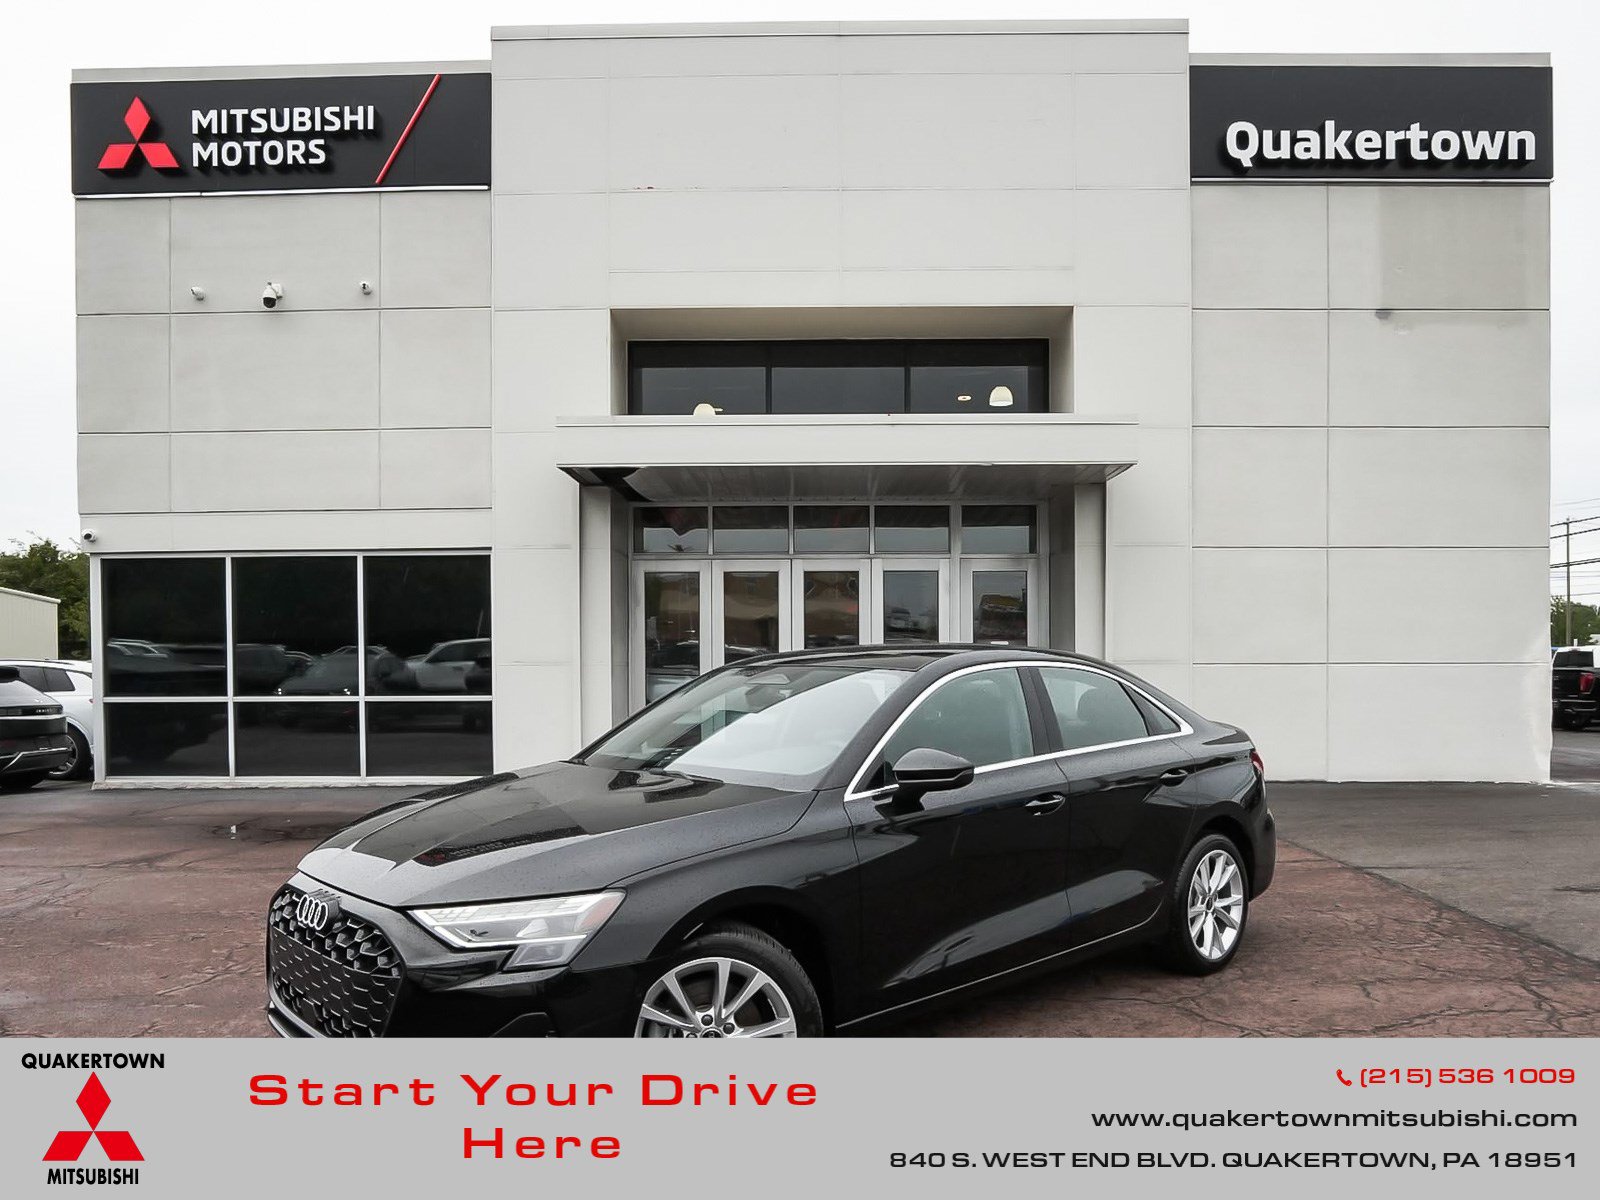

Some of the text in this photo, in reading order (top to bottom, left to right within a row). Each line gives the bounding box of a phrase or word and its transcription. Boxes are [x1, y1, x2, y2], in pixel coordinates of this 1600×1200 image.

[192, 105, 374, 135] MITSUBISHI
[192, 139, 326, 167] MOTORS
[1226, 120, 1536, 168] Quakertown
